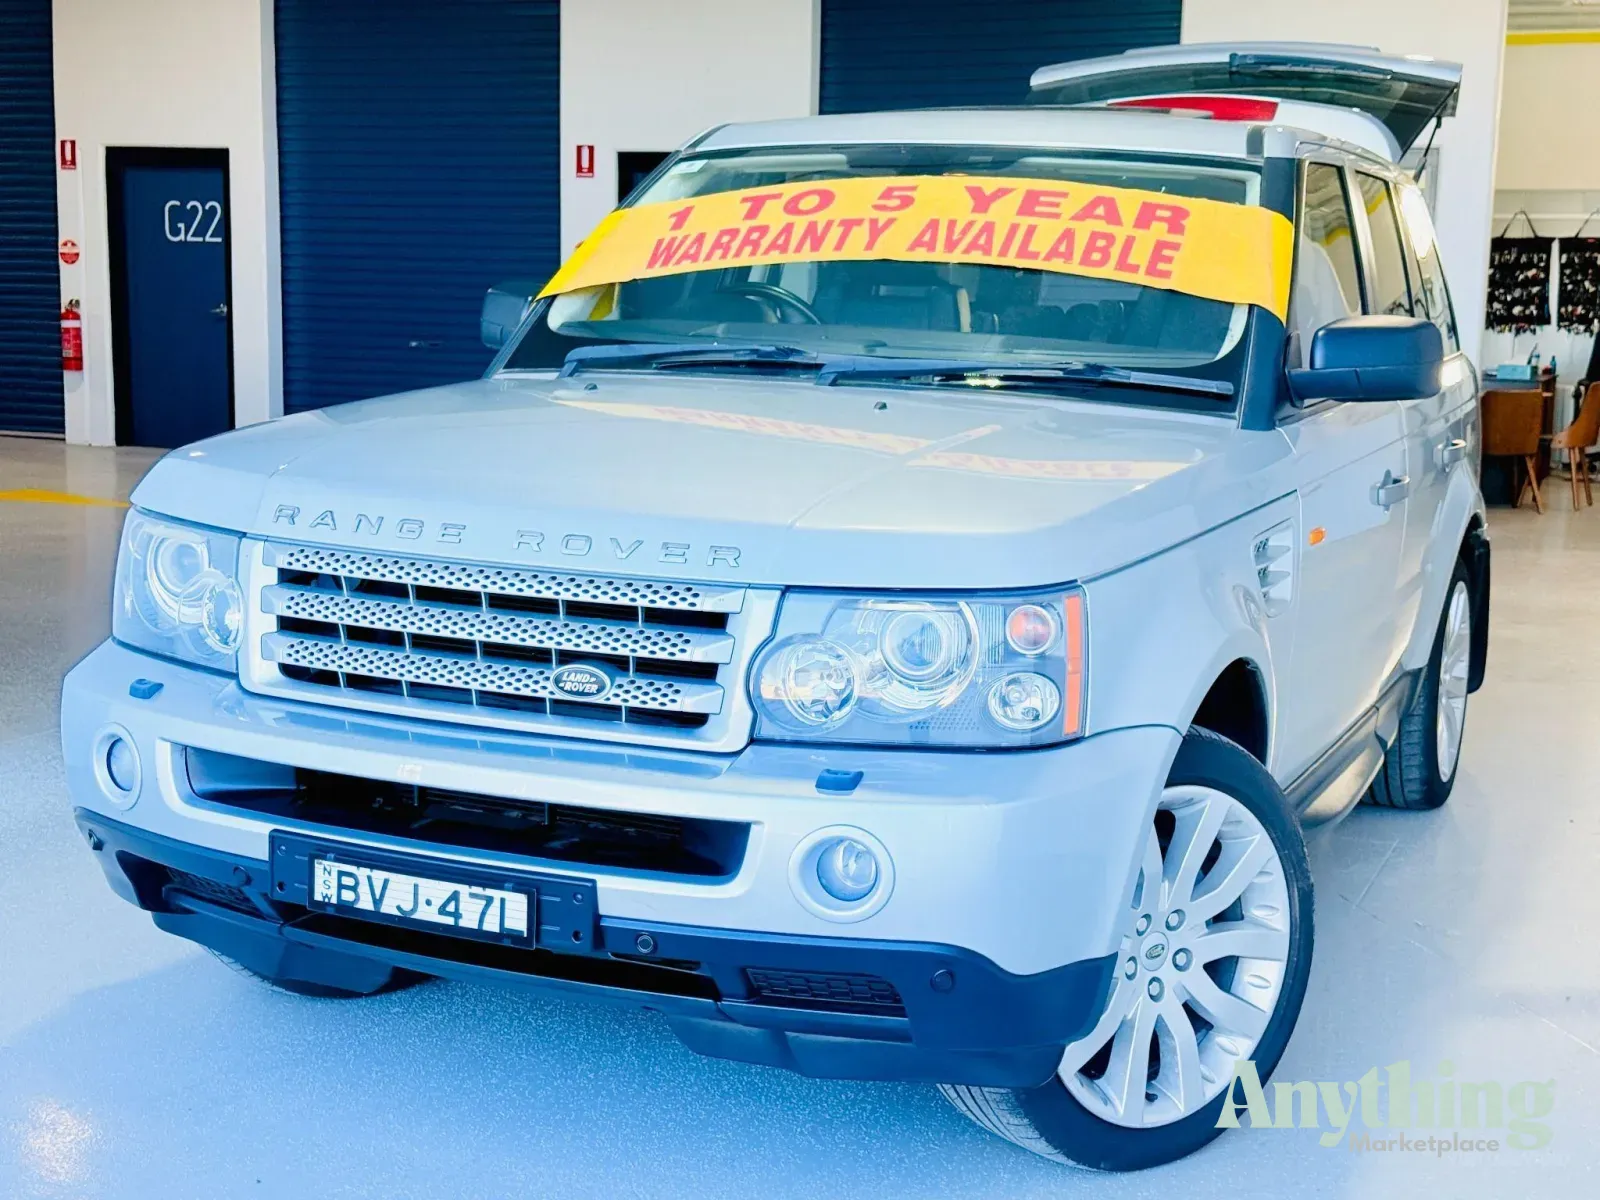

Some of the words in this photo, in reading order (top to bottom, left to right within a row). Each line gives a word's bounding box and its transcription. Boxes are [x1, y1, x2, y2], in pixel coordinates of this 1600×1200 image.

[164, 200, 222, 243] G22
[667, 206, 695, 231] 1
[741, 188, 836, 220] TO
[871, 185, 918, 211] 5
[964, 186, 1191, 236] YEAR
[646, 217, 897, 269] WARRANTY
[906, 218, 1182, 280] AVAILABLE
[271, 503, 467, 545] RANGE
[512, 529, 742, 568] ROVER
[562, 671, 591, 683] LAND
[563, 681, 599, 694] ROVER
[321, 864, 333, 903] NSW
